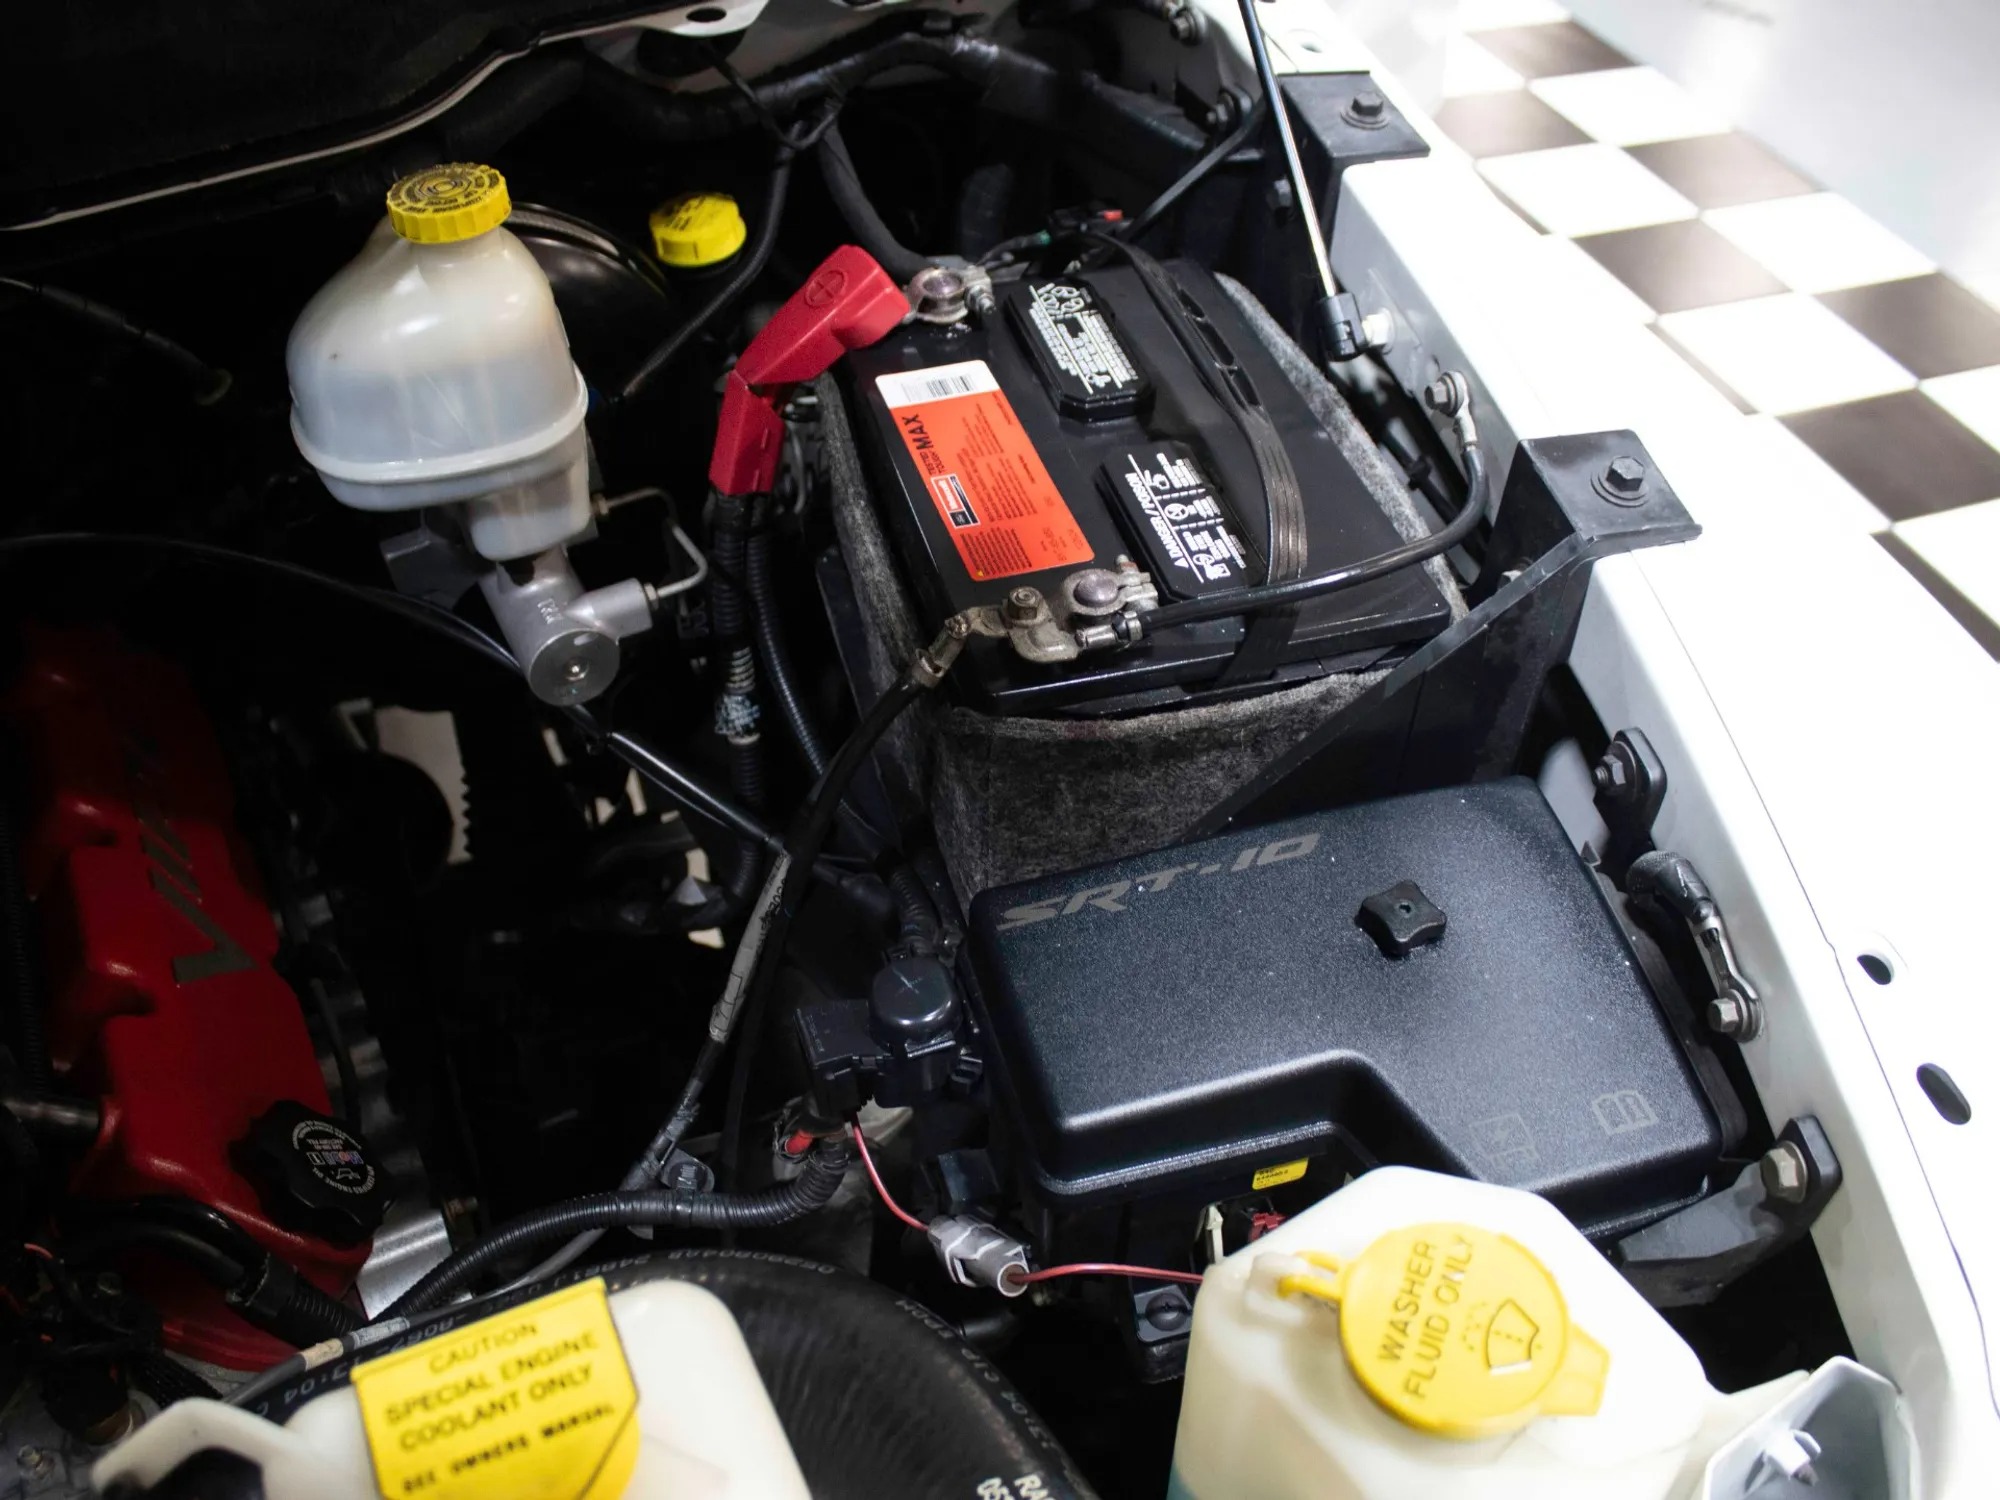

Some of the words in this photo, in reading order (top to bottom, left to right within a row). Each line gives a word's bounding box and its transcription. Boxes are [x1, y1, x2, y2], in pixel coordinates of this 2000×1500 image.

[902, 414, 933, 450] MAX
[920, 451, 937, 475] TESTED
[997, 833, 1321, 931] SRT-10
[1378, 1240, 1437, 1363] WASHER
[1403, 1310, 1448, 1399] FLUID
[1445, 1232, 1474, 1309] ONLY
[385, 1374, 492, 1424] SPECIAL
[500, 1330, 599, 1381] ENGINE
[429, 1321, 538, 1373] CAUTION
[400, 1392, 523, 1450] COOLANT
[529, 1364, 593, 1403] ONLY
[402, 1469, 437, 1493] SEE
[450, 1434, 531, 1473] OWNERS
[542, 1403, 615, 1438] MANUAL
